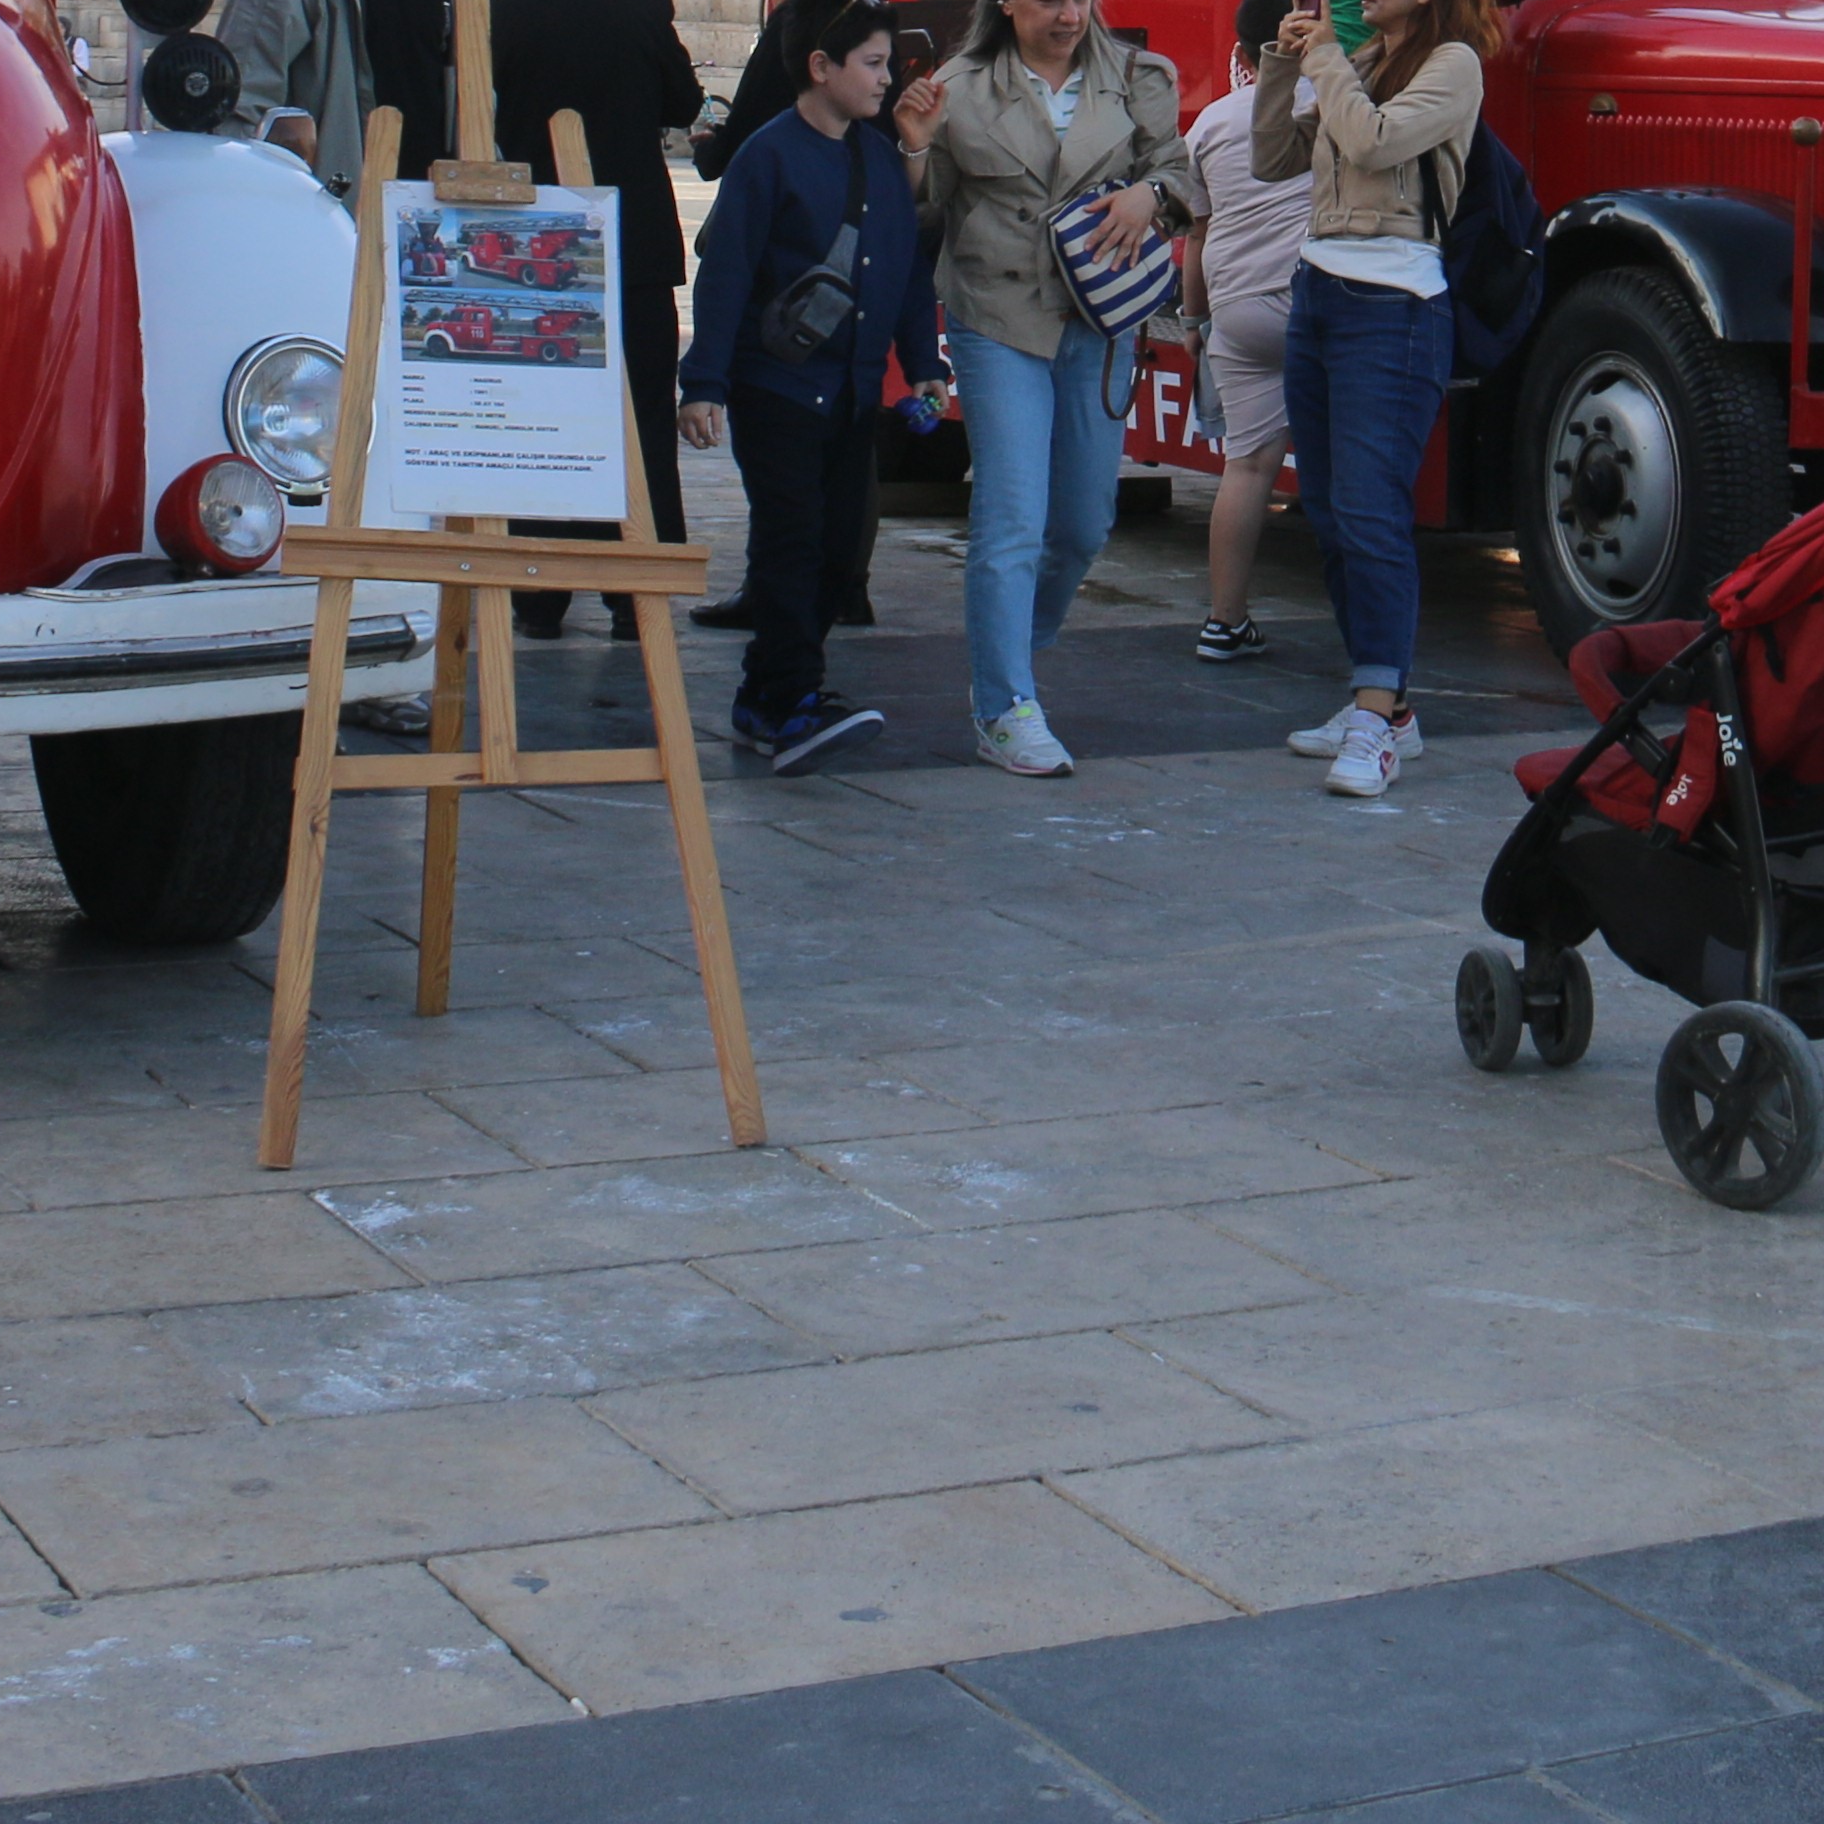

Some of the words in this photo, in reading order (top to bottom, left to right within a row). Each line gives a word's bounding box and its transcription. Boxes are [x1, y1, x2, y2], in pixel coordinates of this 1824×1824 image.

[405, 458, 439, 466] GÖSTERİ
[428, 449, 449, 458] ARAÇ
[1716, 712, 1743, 767] Joie
[1666, 774, 1693, 806] Joie
